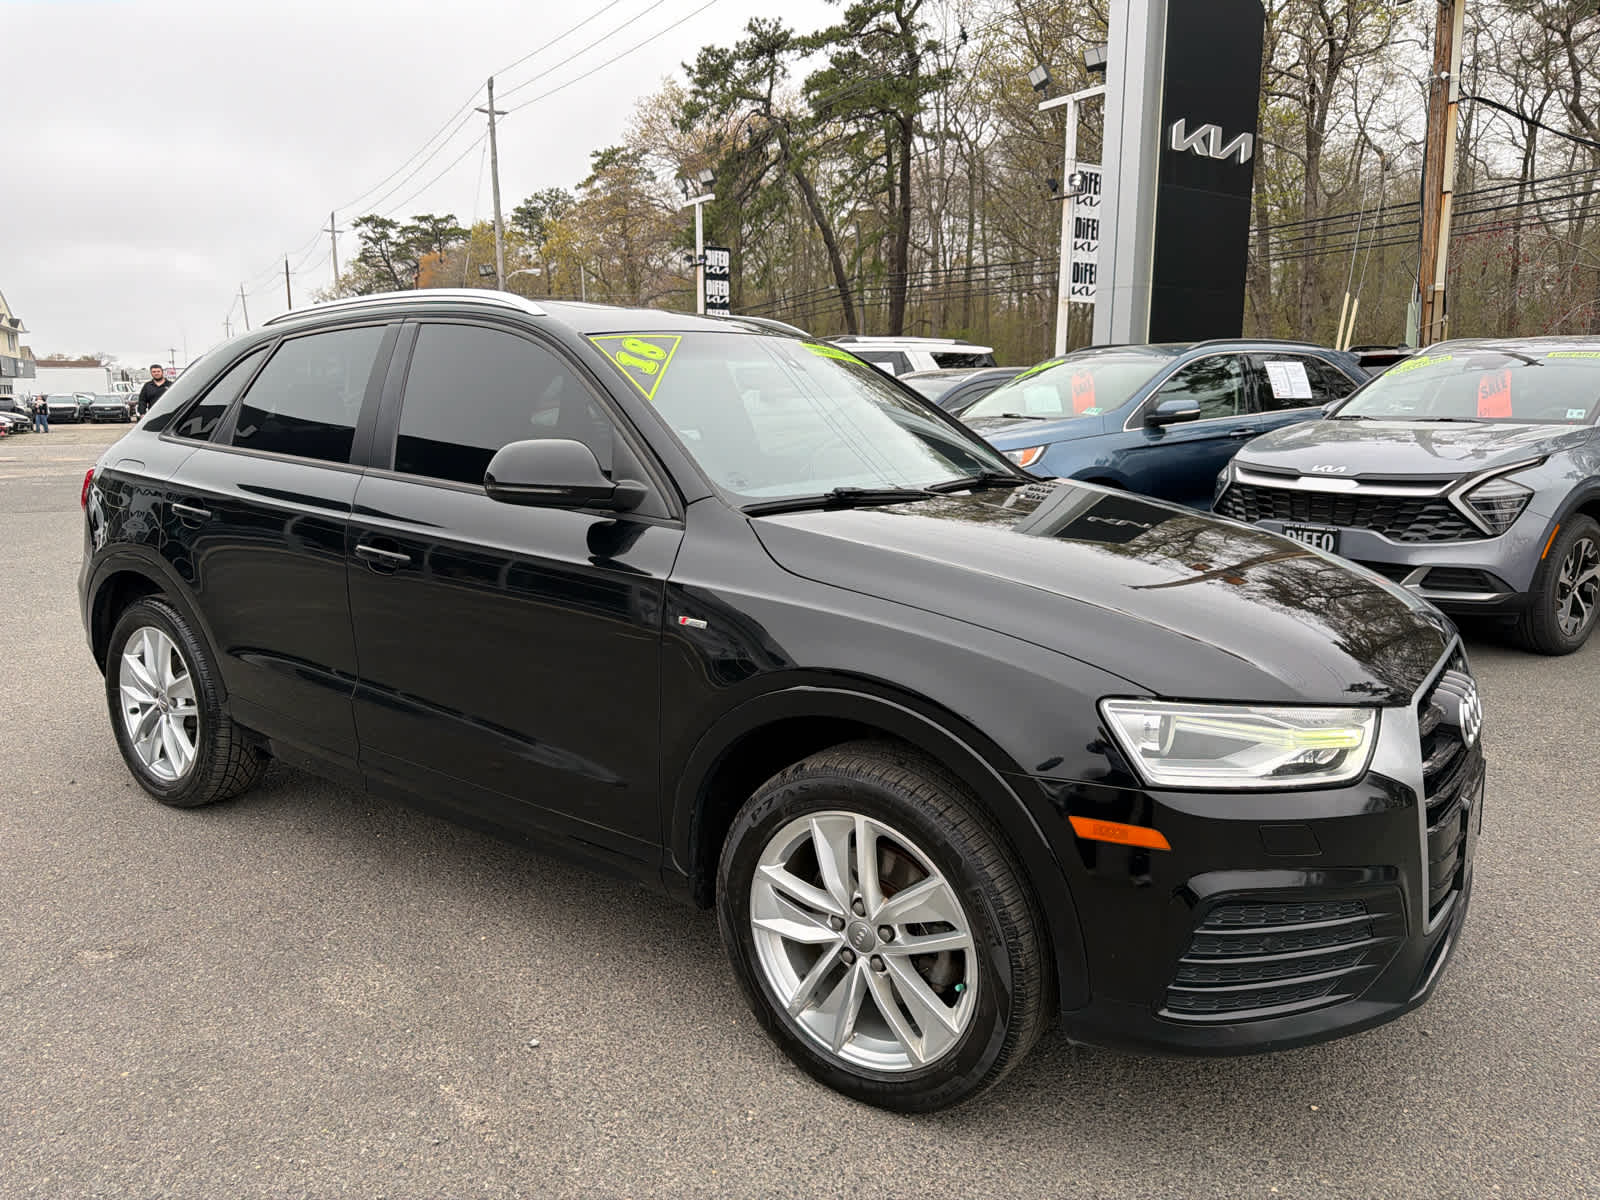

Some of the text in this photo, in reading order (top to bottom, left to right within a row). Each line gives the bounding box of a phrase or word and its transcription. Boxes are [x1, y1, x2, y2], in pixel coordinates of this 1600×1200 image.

[1171, 118, 1254, 164] KIA
[1072, 262, 1097, 285] DiFE
[616, 337, 667, 375] 18
[1480, 372, 1509, 399] SALE
[1311, 464, 1347, 473] KIA
